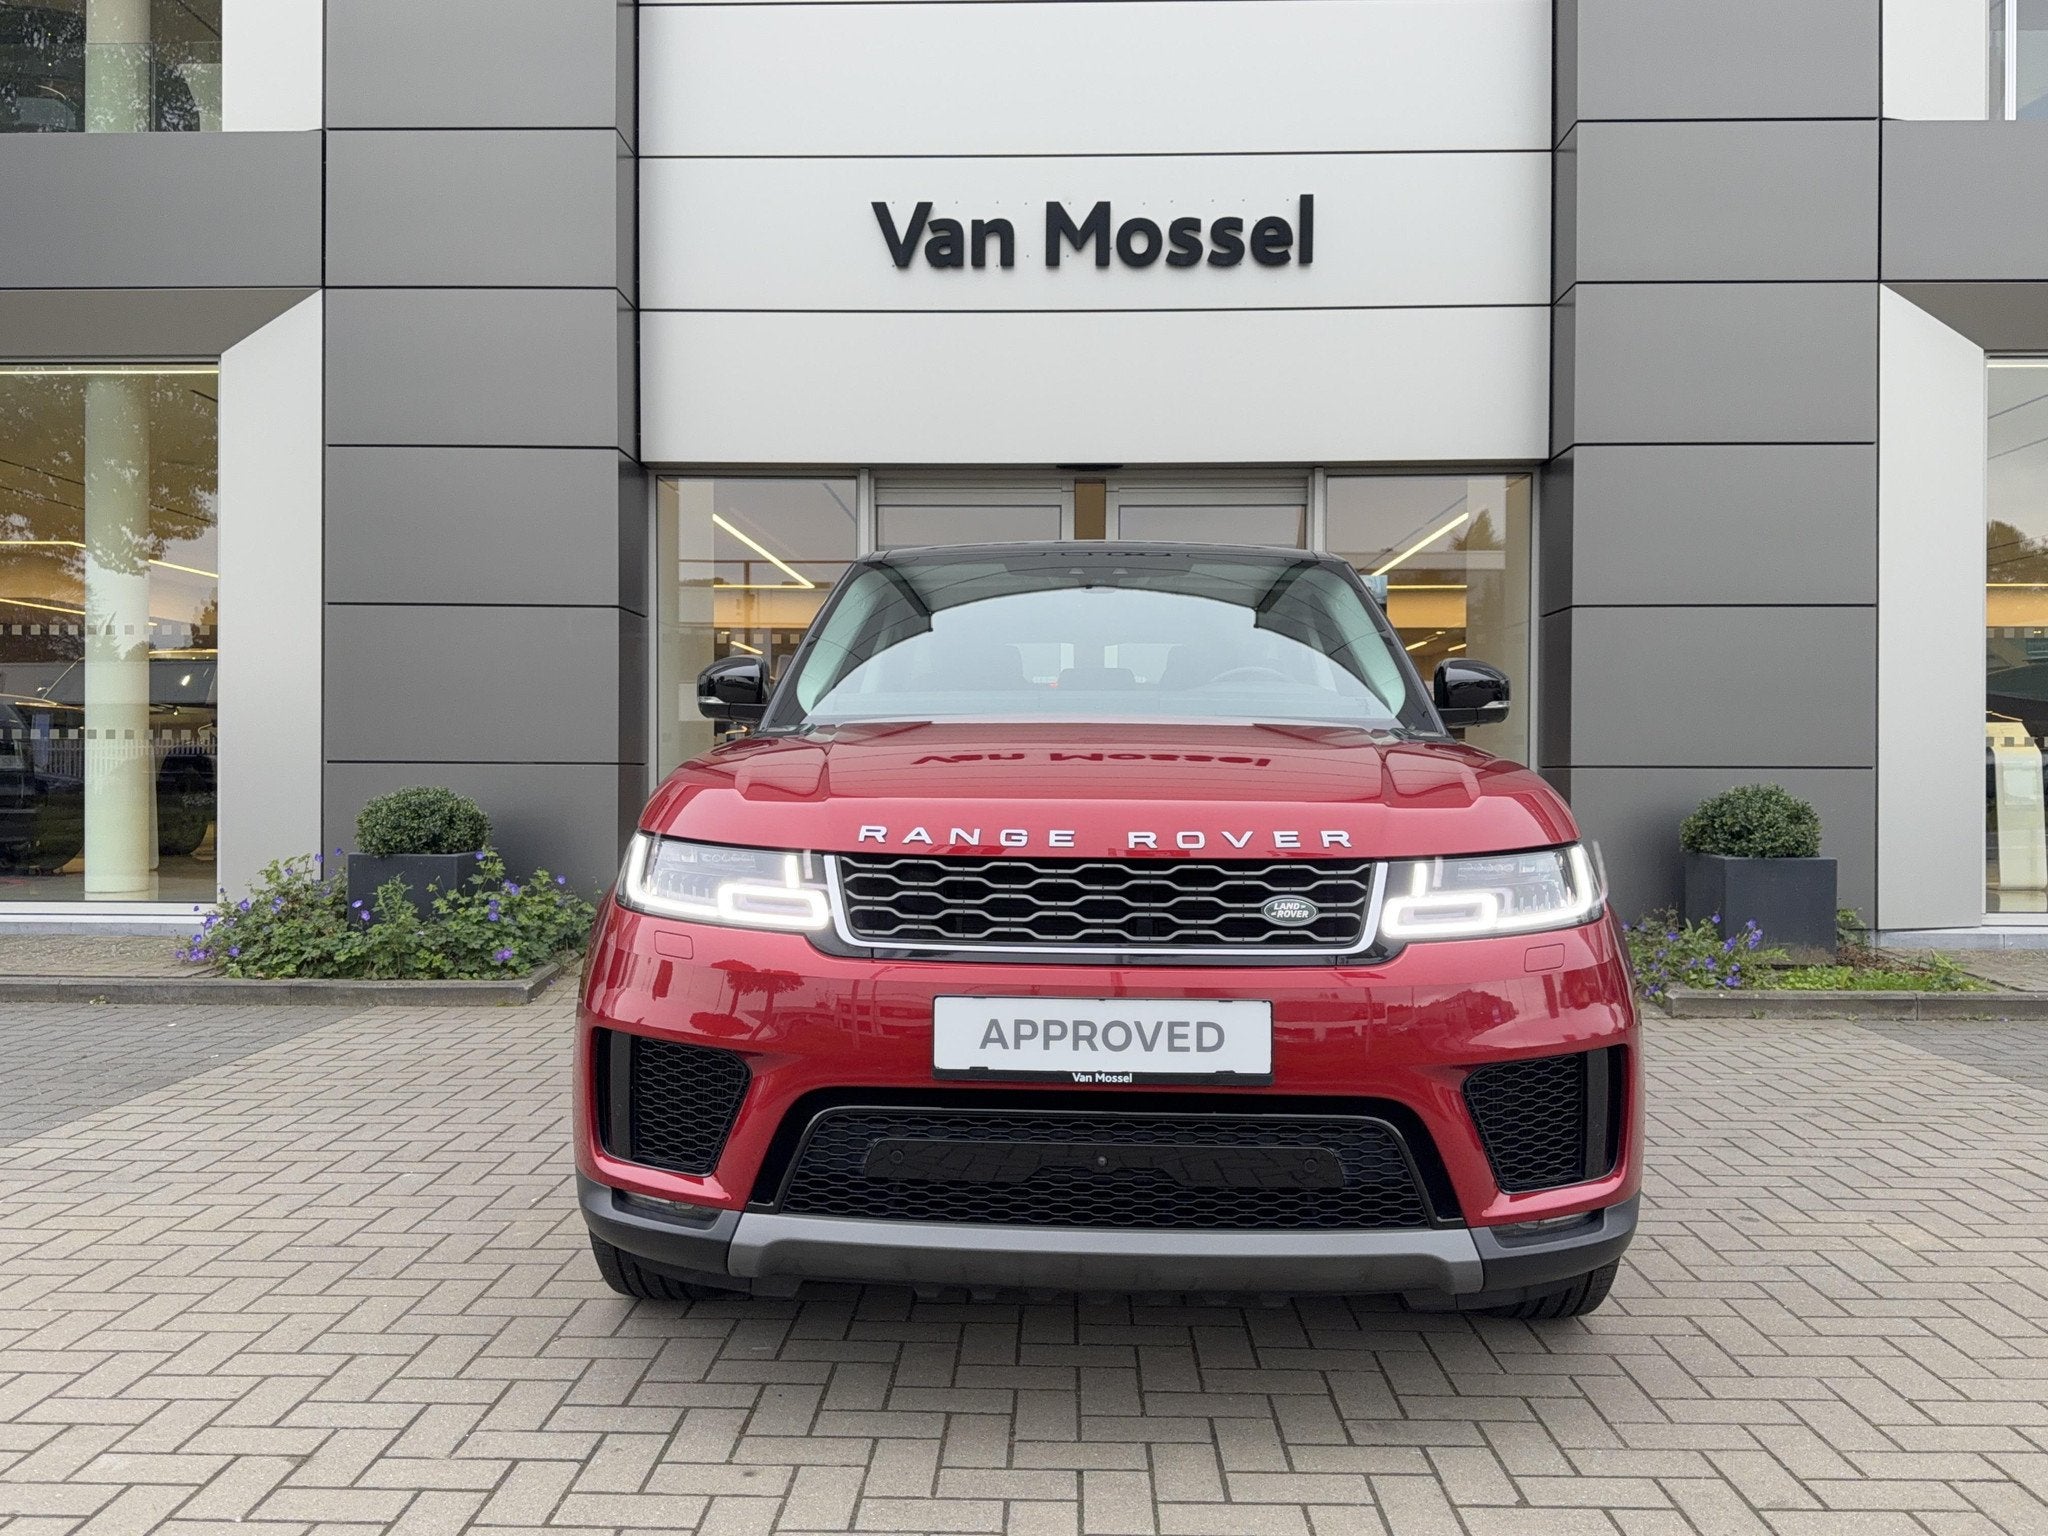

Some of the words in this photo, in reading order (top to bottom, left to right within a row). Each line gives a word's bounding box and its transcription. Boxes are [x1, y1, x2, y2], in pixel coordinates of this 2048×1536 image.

[871, 201, 1015, 268] Van
[1045, 194, 1314, 268] Mossel
[857, 825, 1076, 848] RANGE
[1127, 829, 1353, 849] ROVER
[1273, 902, 1300, 910] LAND
[1276, 910, 1309, 918] ROVER
[979, 1018, 1226, 1053] APPROVED
[1072, 1072, 1093, 1083] Van
[1095, 1072, 1133, 1083] Mossel
